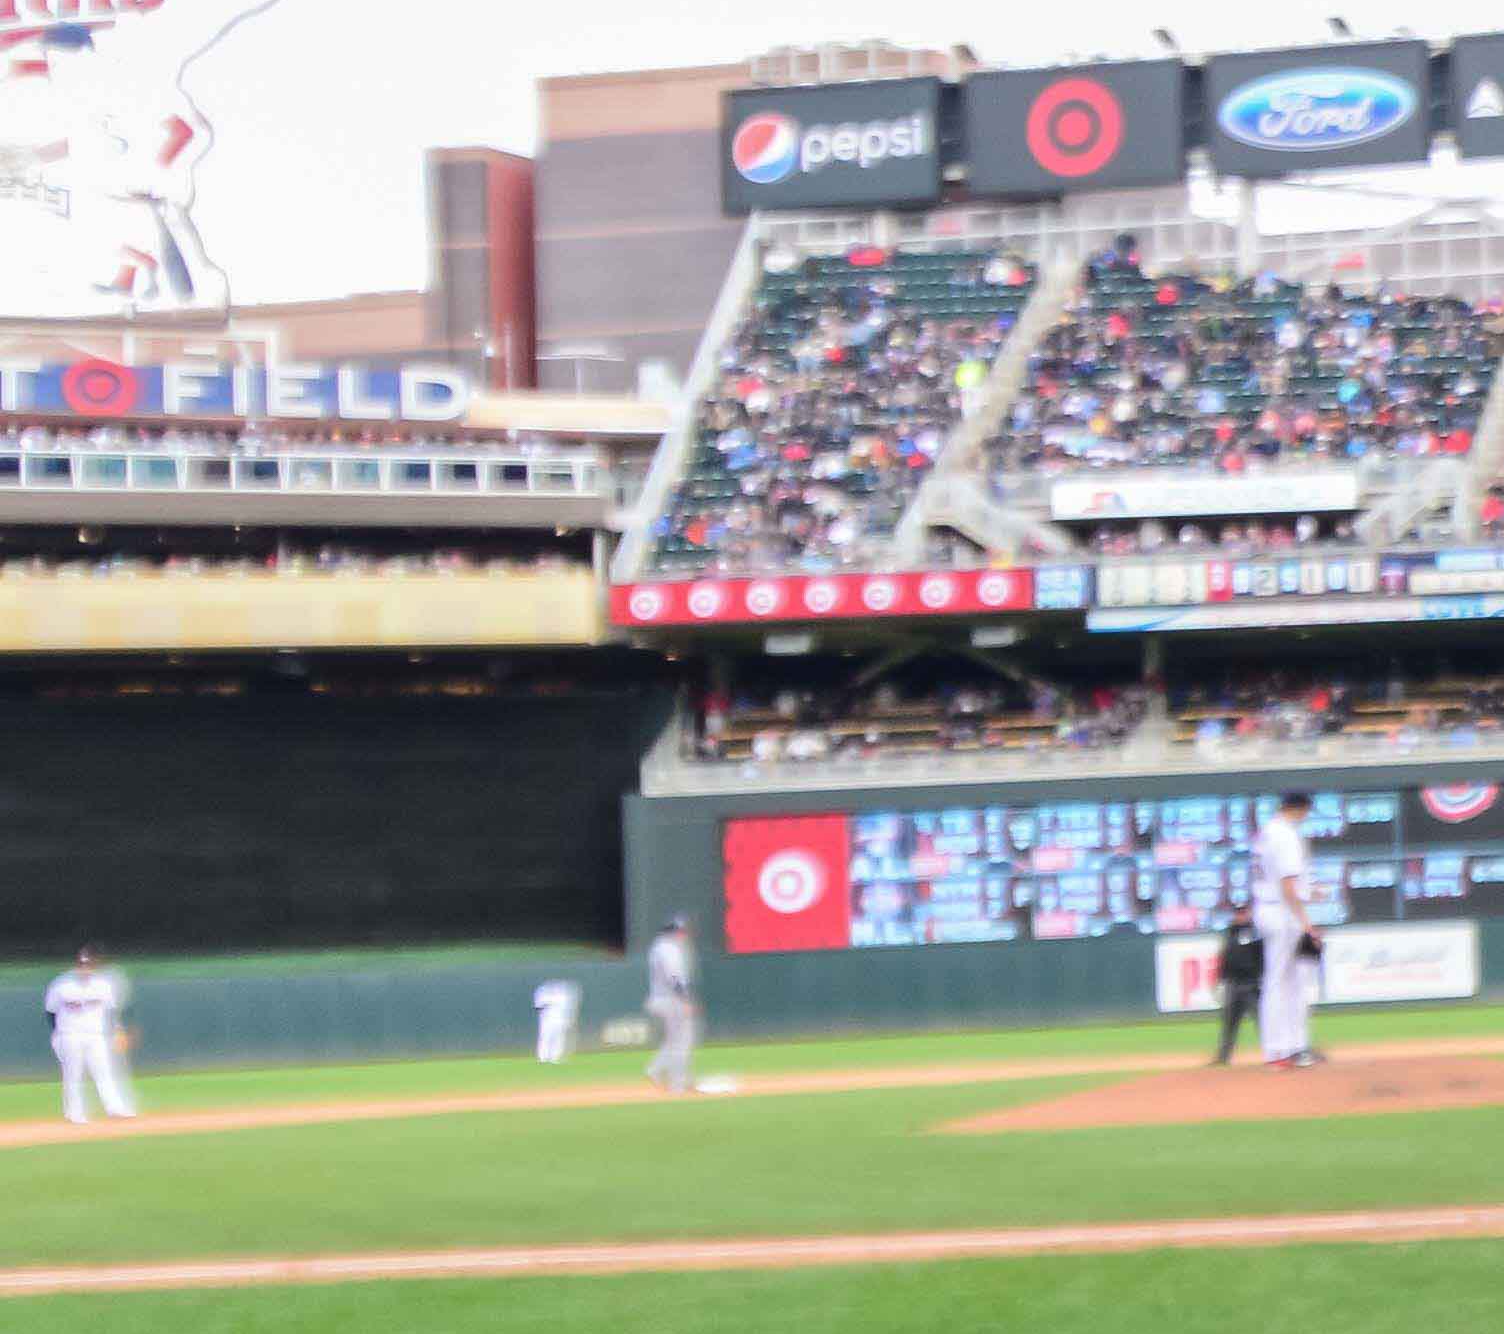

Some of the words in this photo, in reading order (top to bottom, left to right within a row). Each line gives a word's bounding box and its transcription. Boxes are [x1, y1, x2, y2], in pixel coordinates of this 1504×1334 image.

[1257, 84, 1372, 139] Ford
[801, 114, 928, 173] pepsi
[164, 363, 468, 422] FIELD
